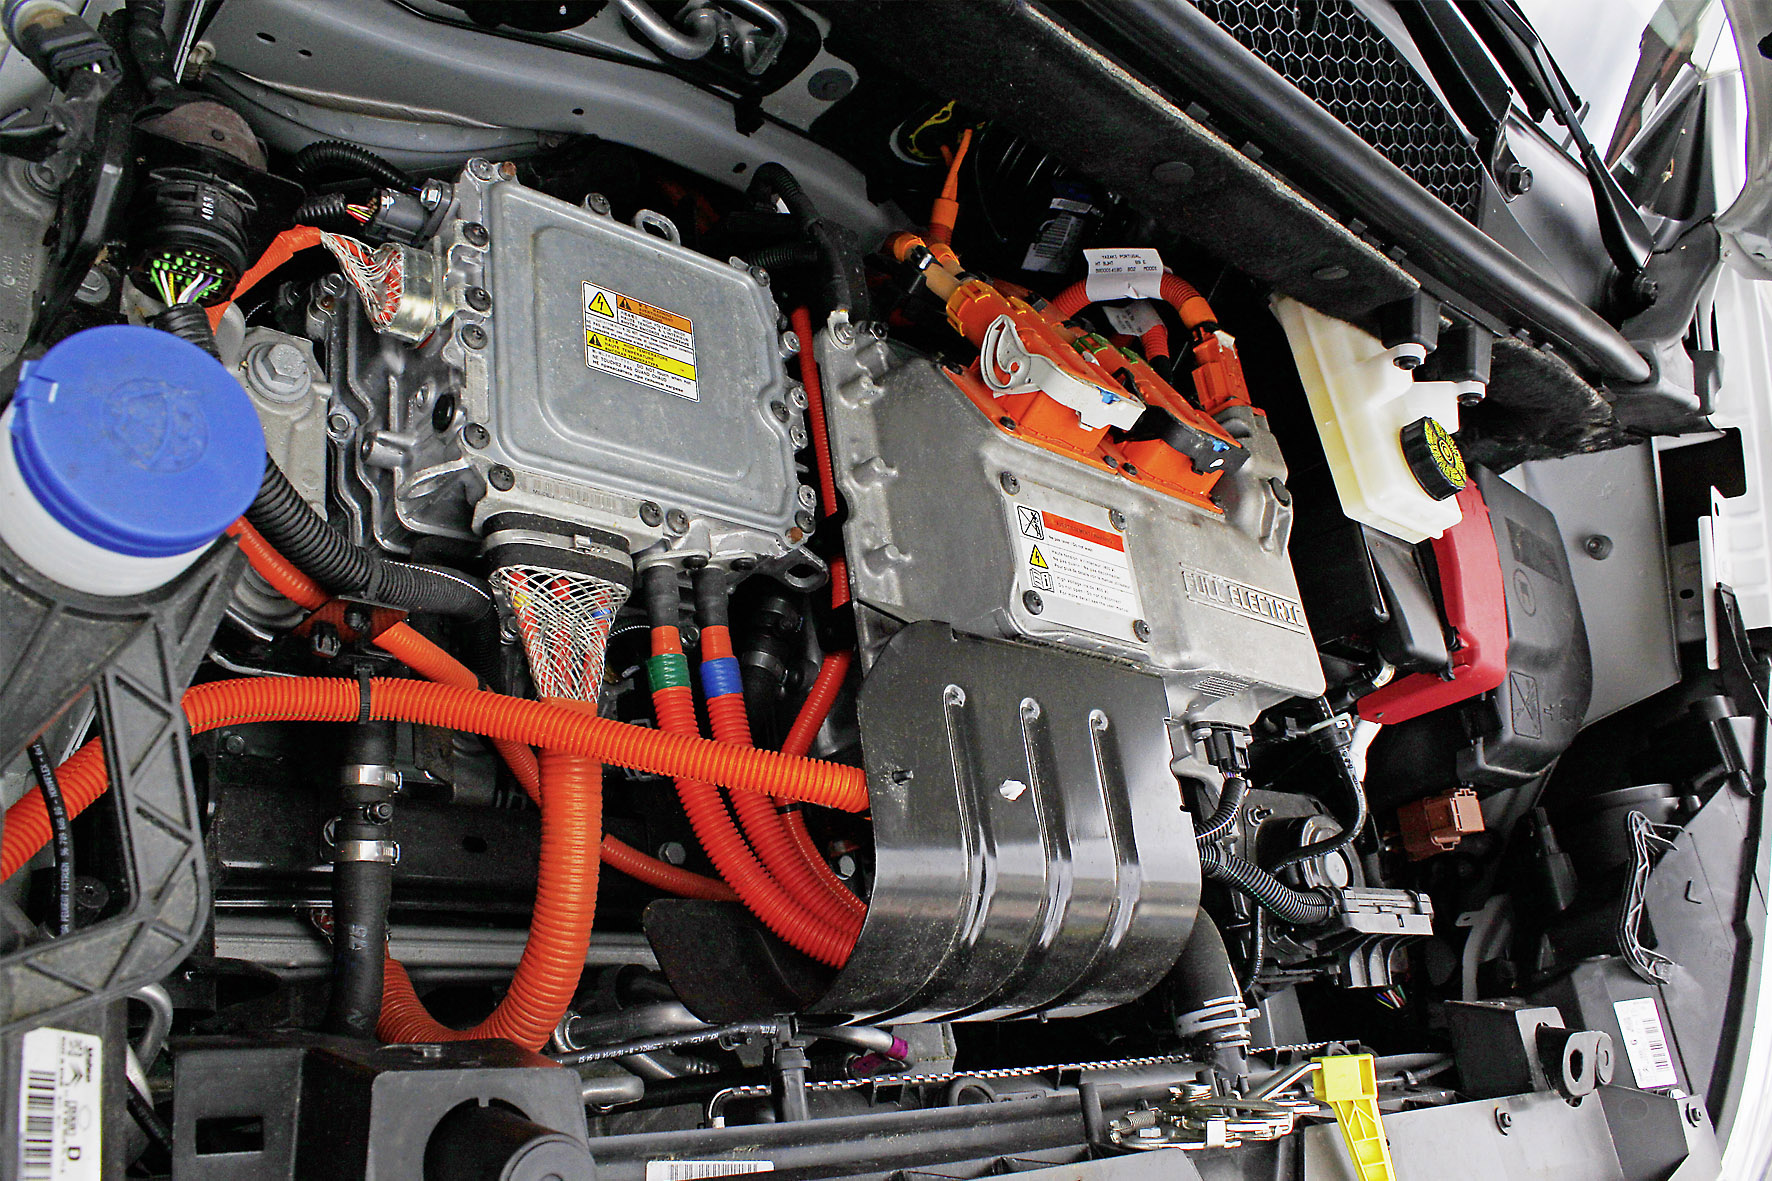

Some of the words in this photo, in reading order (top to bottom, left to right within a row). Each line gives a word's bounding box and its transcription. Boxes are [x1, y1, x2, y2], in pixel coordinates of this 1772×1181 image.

[1181, 570, 1225, 604] FULL
[1227, 585, 1304, 628] ELECTRIC
[61, 862, 70, 891] CITROEN
[60, 894, 69, 922] PEUGEOT
[67, 1146, 81, 1161] D
